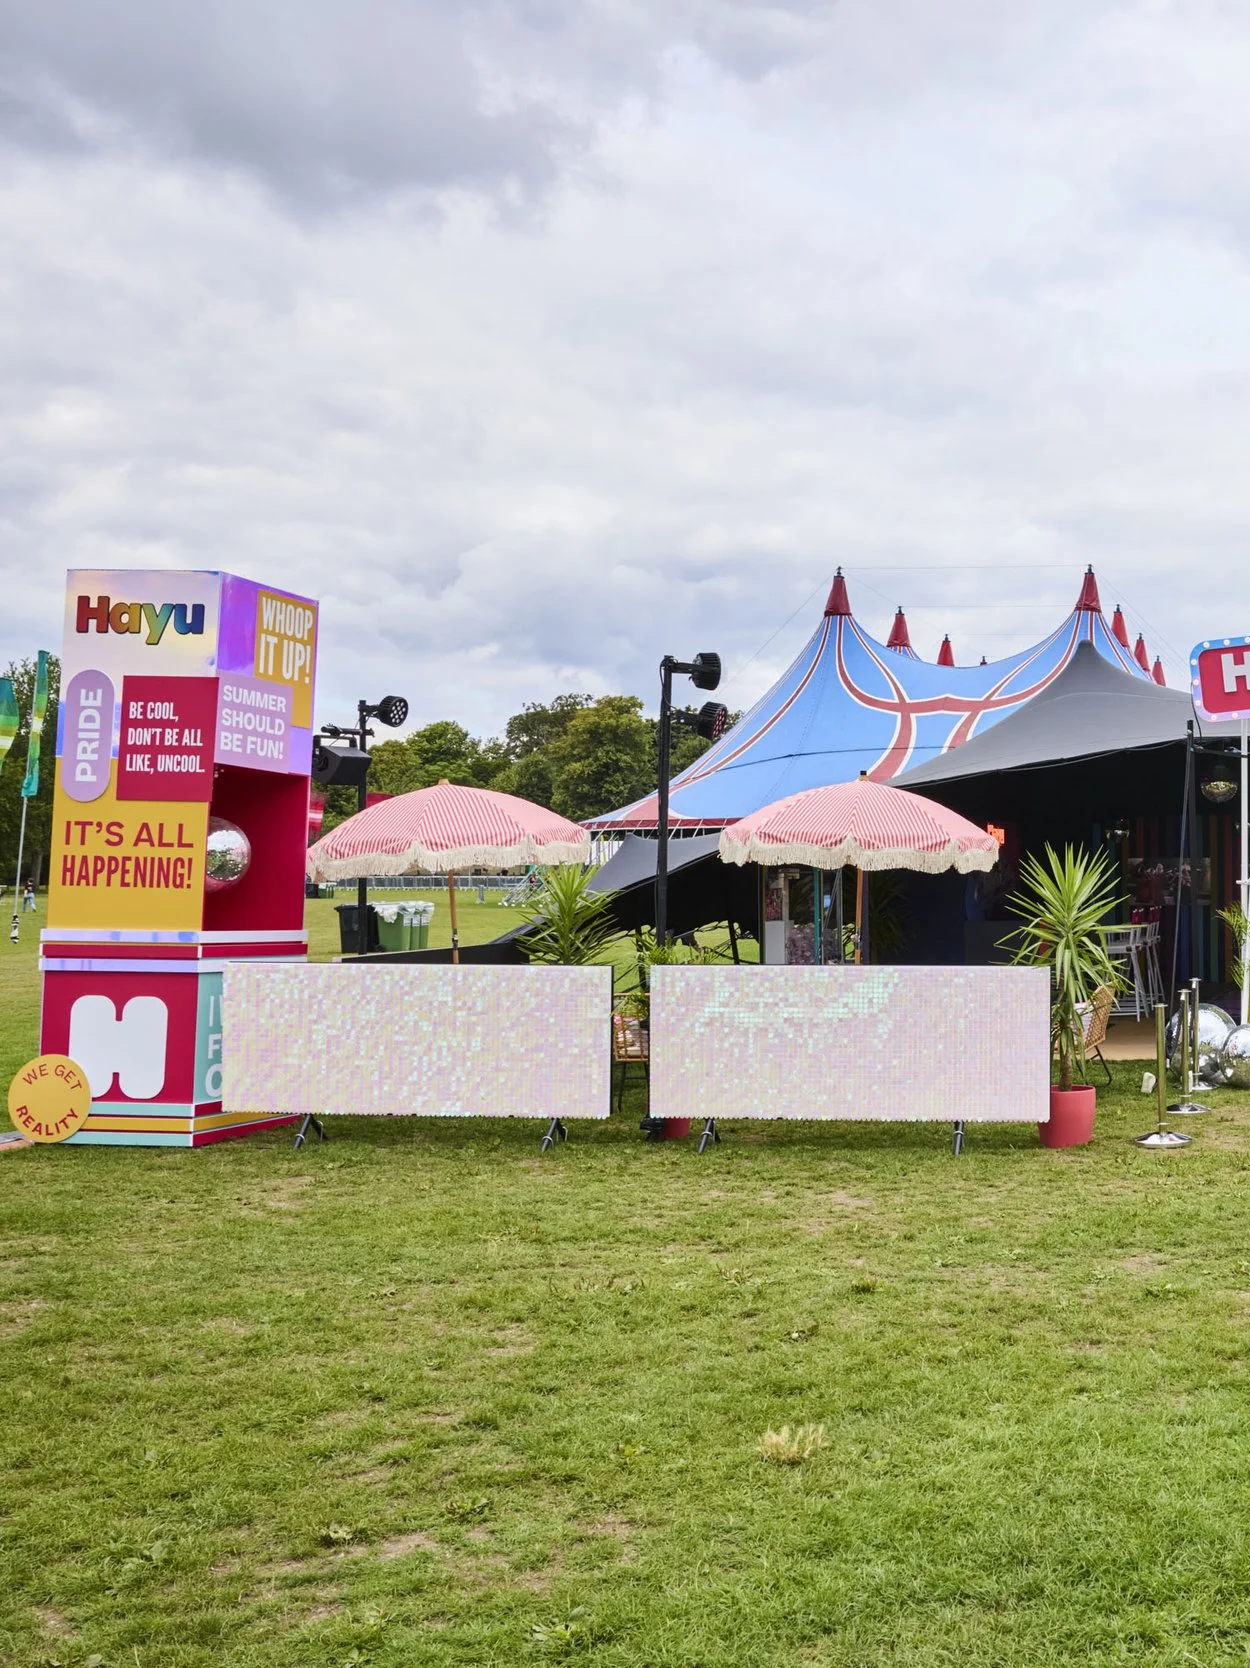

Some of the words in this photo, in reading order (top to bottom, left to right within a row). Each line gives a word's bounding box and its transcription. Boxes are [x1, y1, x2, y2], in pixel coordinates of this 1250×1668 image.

[76, 595, 205, 645] Hayu
[261, 596, 313, 637] WHOOP
[259, 635, 278, 676] IT
[282, 643, 311, 684] UP!
[129, 702, 144, 719] BE
[147, 702, 179, 722] COOL,
[223, 684, 287, 713] SUMMER
[75, 688, 103, 782] PRIDE
[222, 708, 285, 736] SHOULD
[127, 728, 162, 747] DON'T
[164, 729, 179, 746] BE
[182, 729, 203, 747] ALL
[220, 731, 243, 751] BE
[247, 735, 284, 759] FUN!
[125, 754, 154, 774] LIKE,
[157, 755, 205, 773] UNCOOL.
[64, 820, 124, 848] IT'S
[133, 822, 194, 849] ALL
[61, 854, 192, 889] HAPPENING!
[22, 1063, 49, 1086] WE
[54, 1064, 82, 1092] GET
[15, 1105, 79, 1137] REALITY
